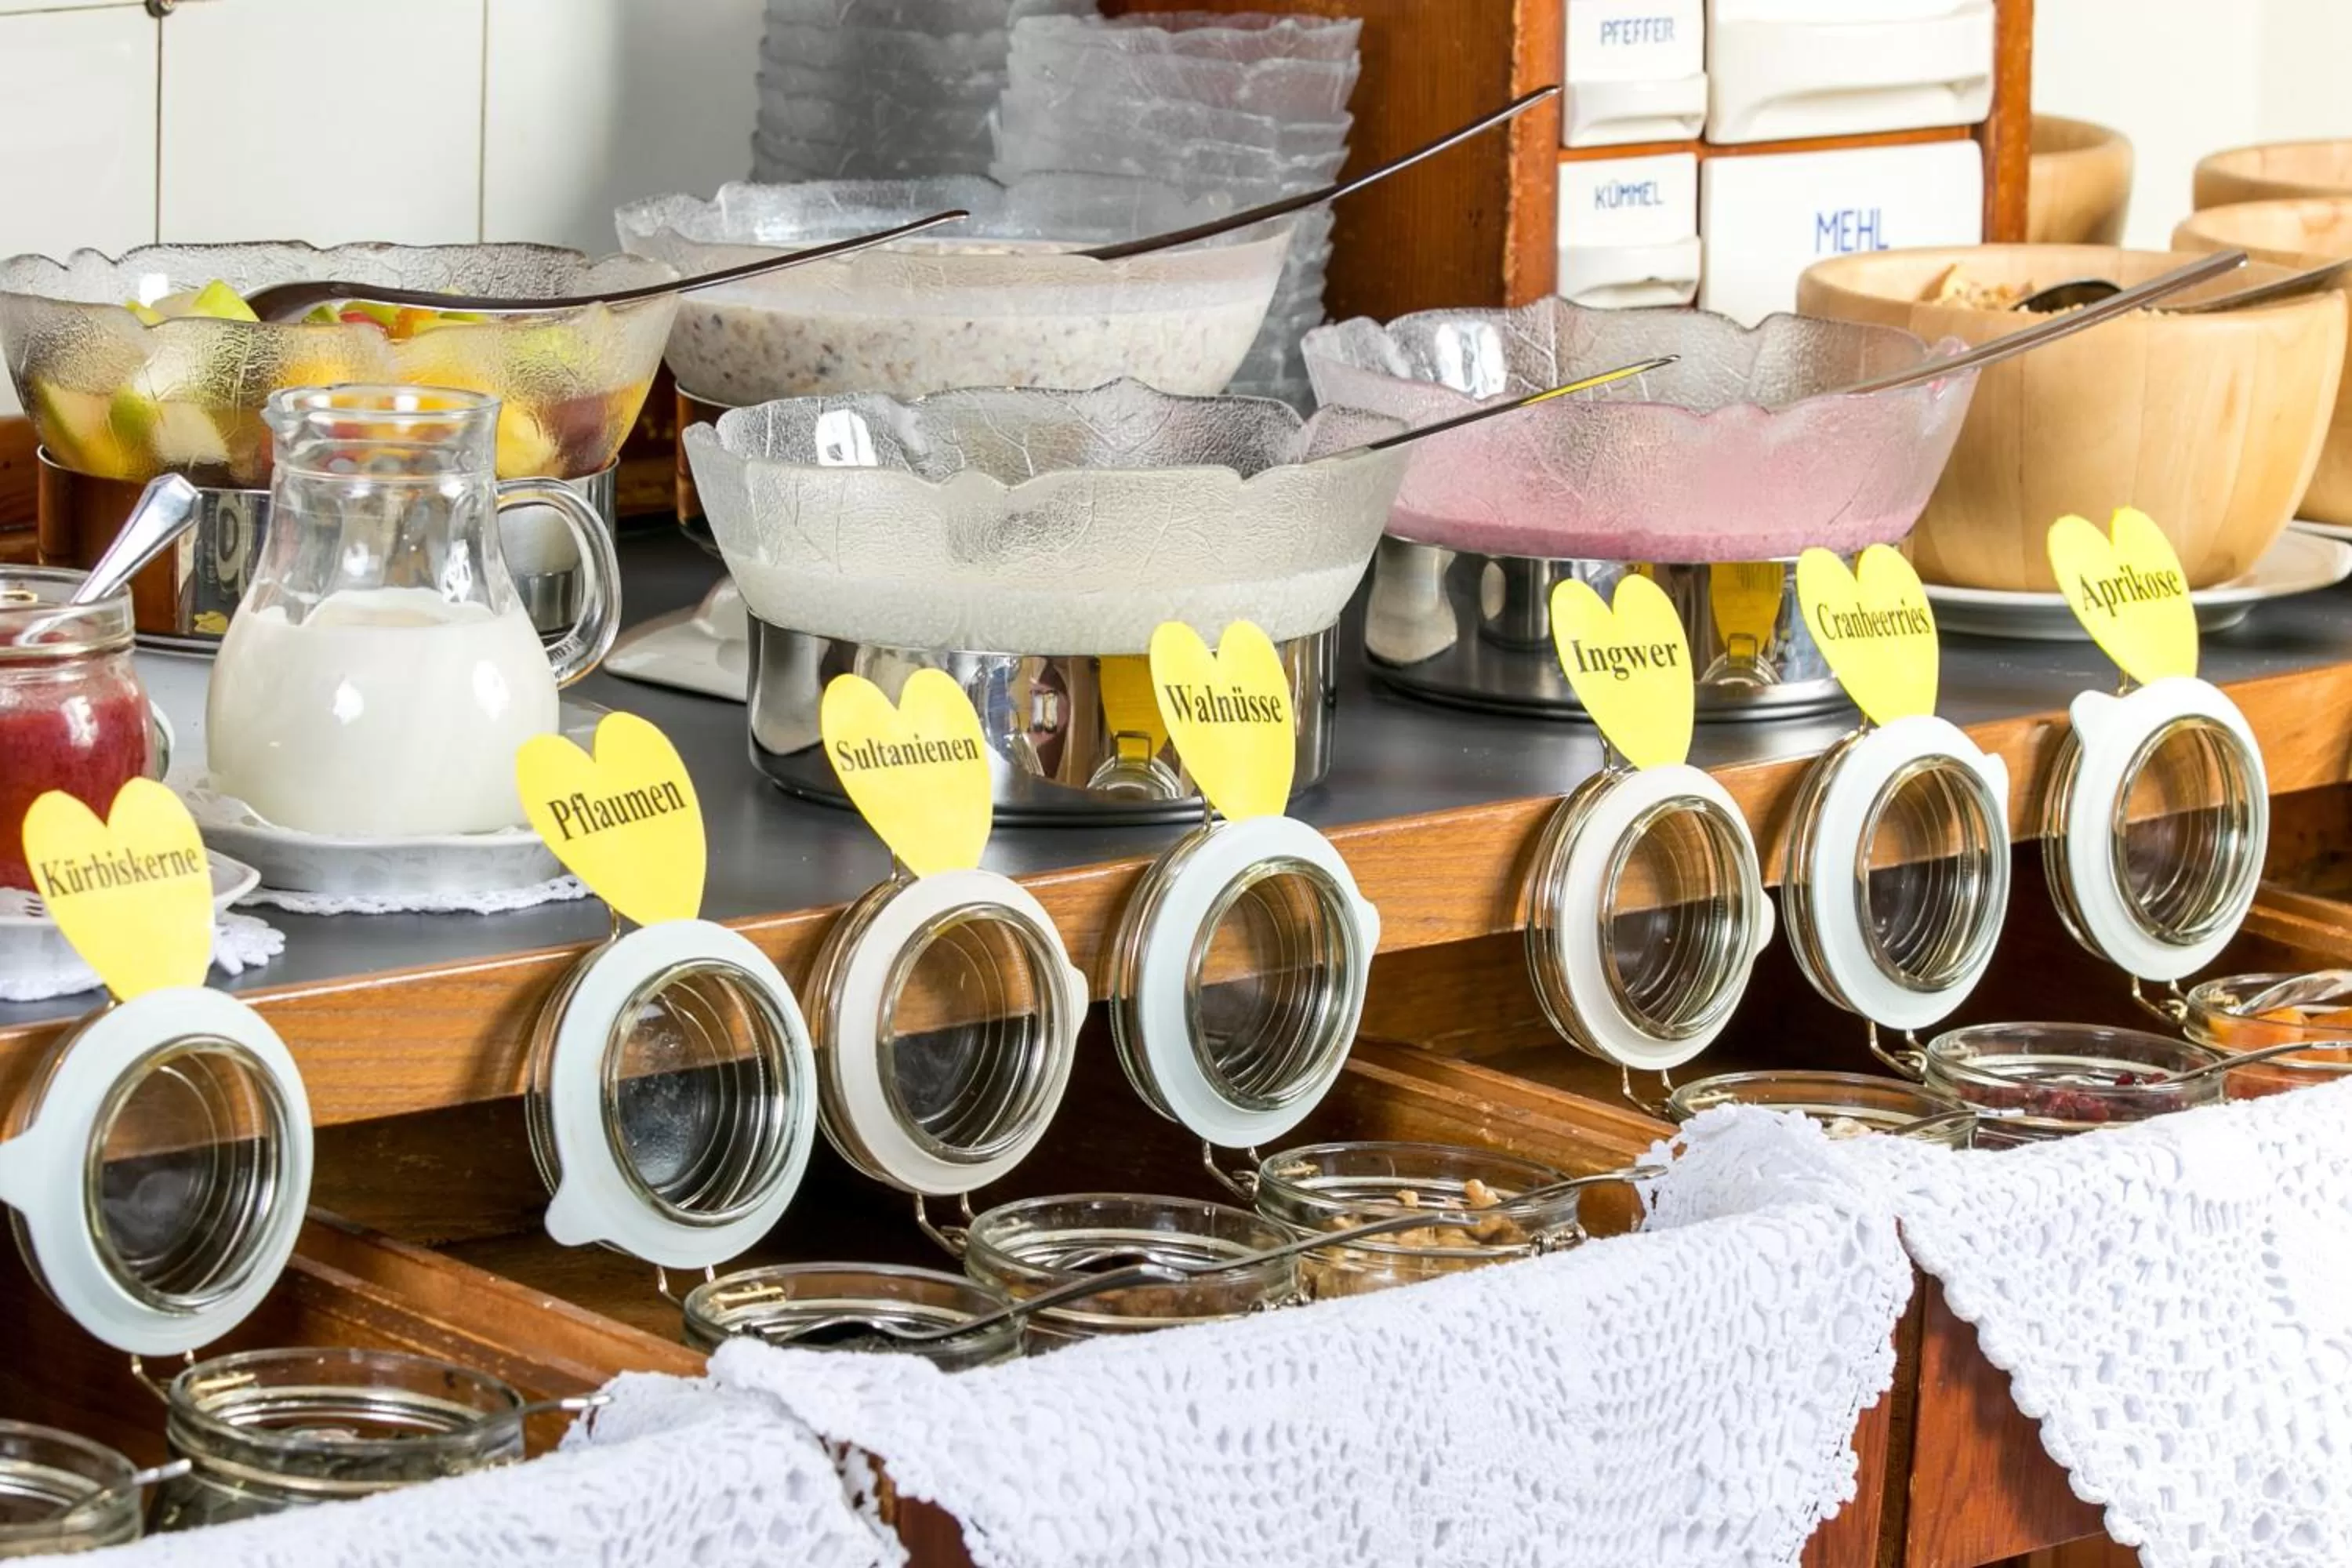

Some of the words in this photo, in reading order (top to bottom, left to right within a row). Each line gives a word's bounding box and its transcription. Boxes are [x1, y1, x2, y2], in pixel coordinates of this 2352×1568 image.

[1600, 17, 1675, 45] PFEFFER
[1595, 180, 1664, 209] KÜMMEL
[1816, 208, 1889, 253] MEHL
[2078, 566, 2183, 617] Aprikose
[1570, 638, 1679, 681] Ingwer
[1164, 684, 1283, 724] Walnüsse
[836, 734, 979, 771] Sultanienen
[546, 779, 688, 841] Pflaumen
[40, 844, 200, 900] Kürbiskerne
